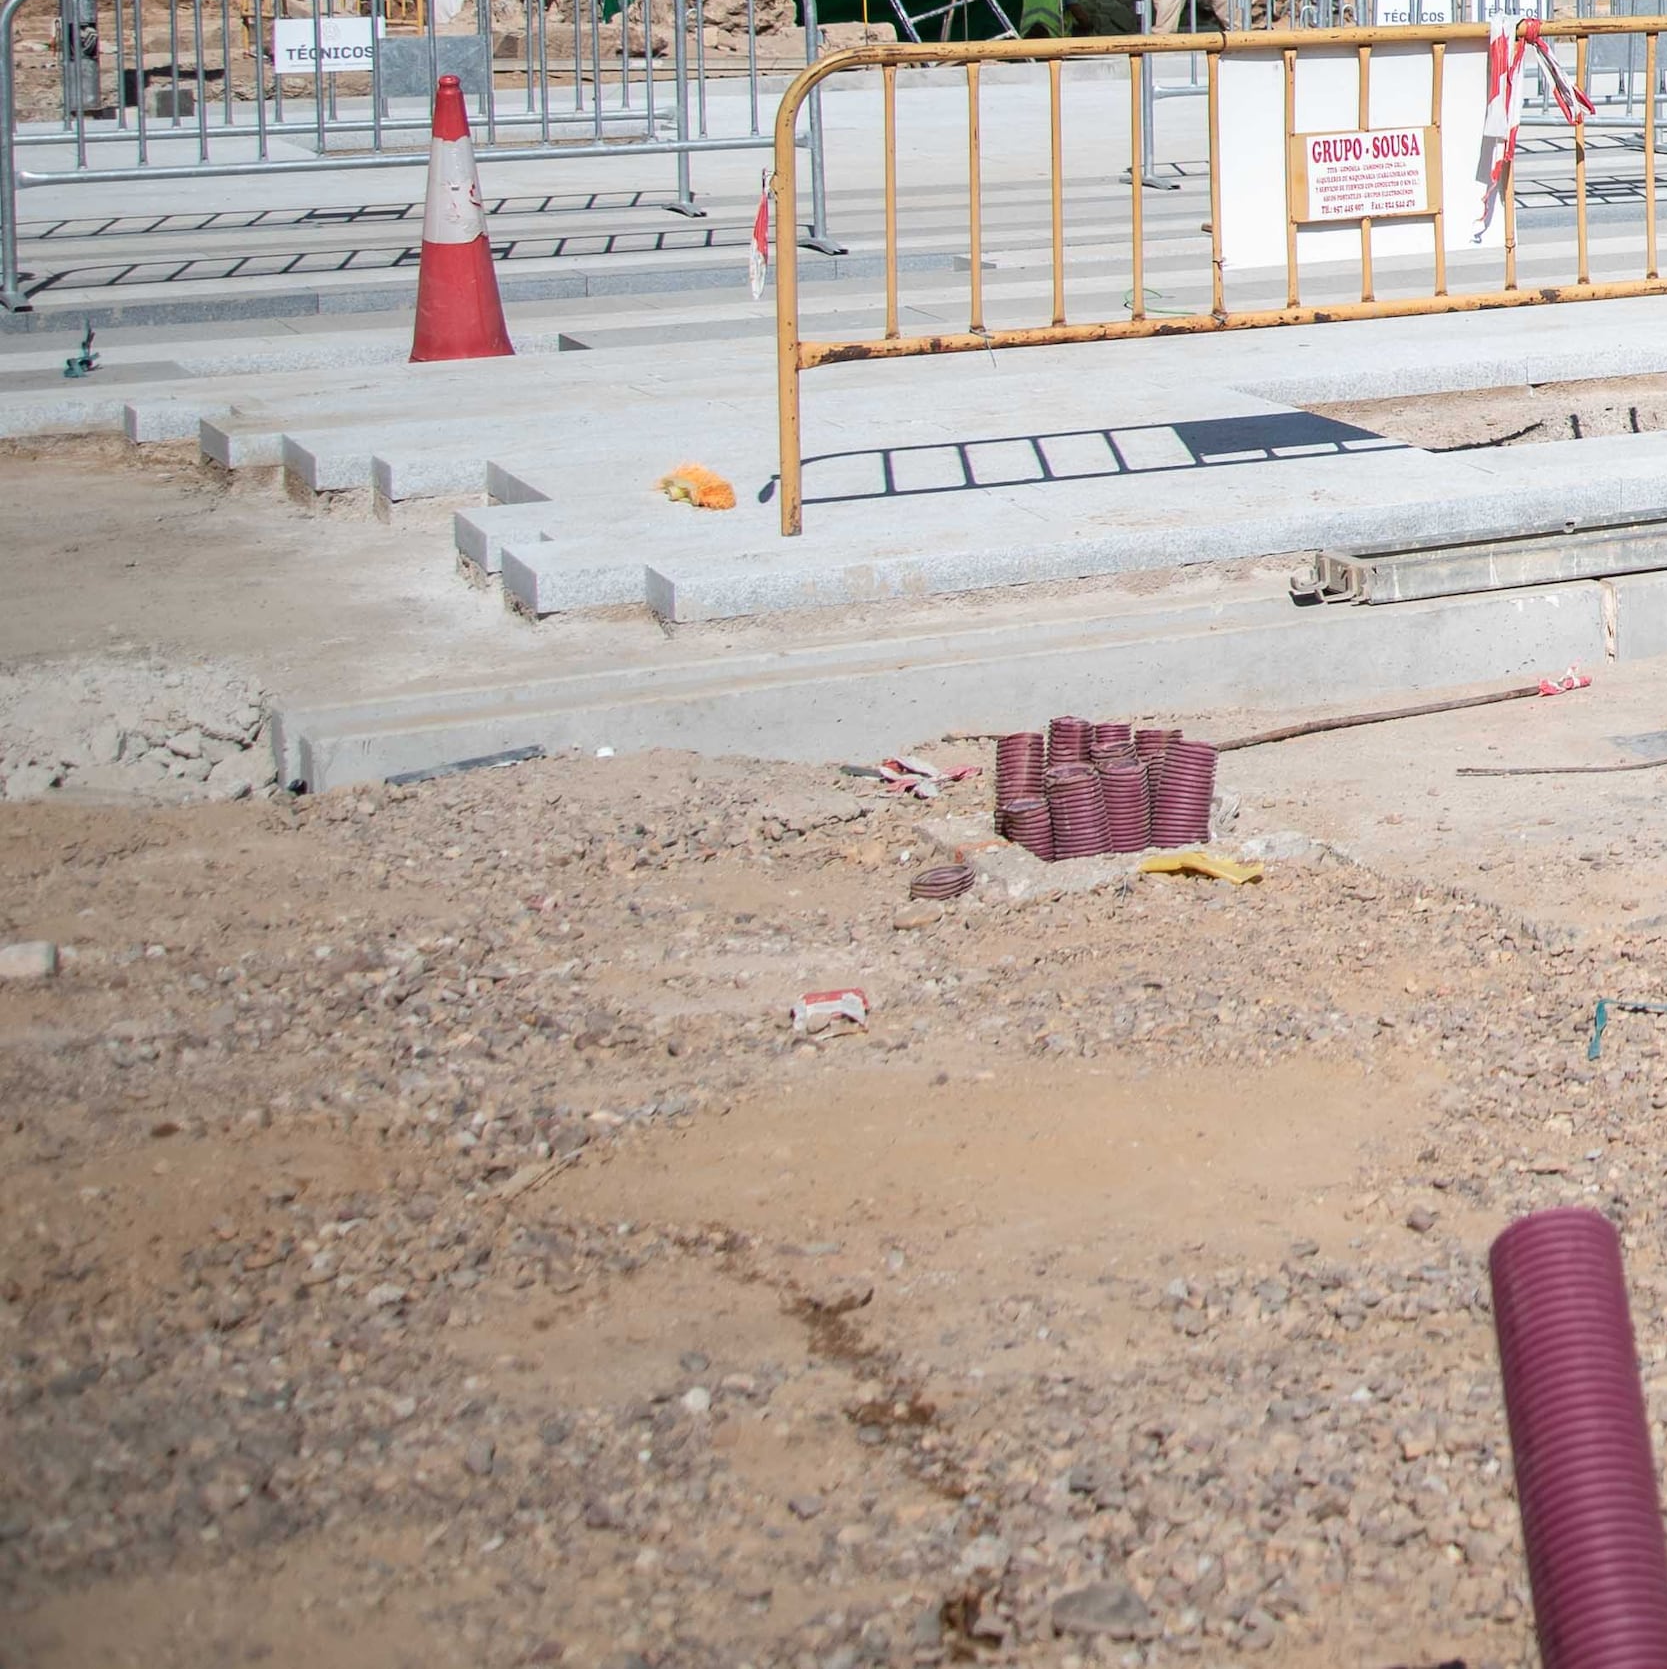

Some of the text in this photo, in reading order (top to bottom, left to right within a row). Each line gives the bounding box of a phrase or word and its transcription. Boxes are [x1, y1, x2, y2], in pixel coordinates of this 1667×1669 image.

[1384, 9, 1445, 23] TÉCCOS
[286, 44, 375, 60] TÉCNICOS
[1312, 138, 1362, 164] GRUPO
[1372, 133, 1421, 159] SOUSA
